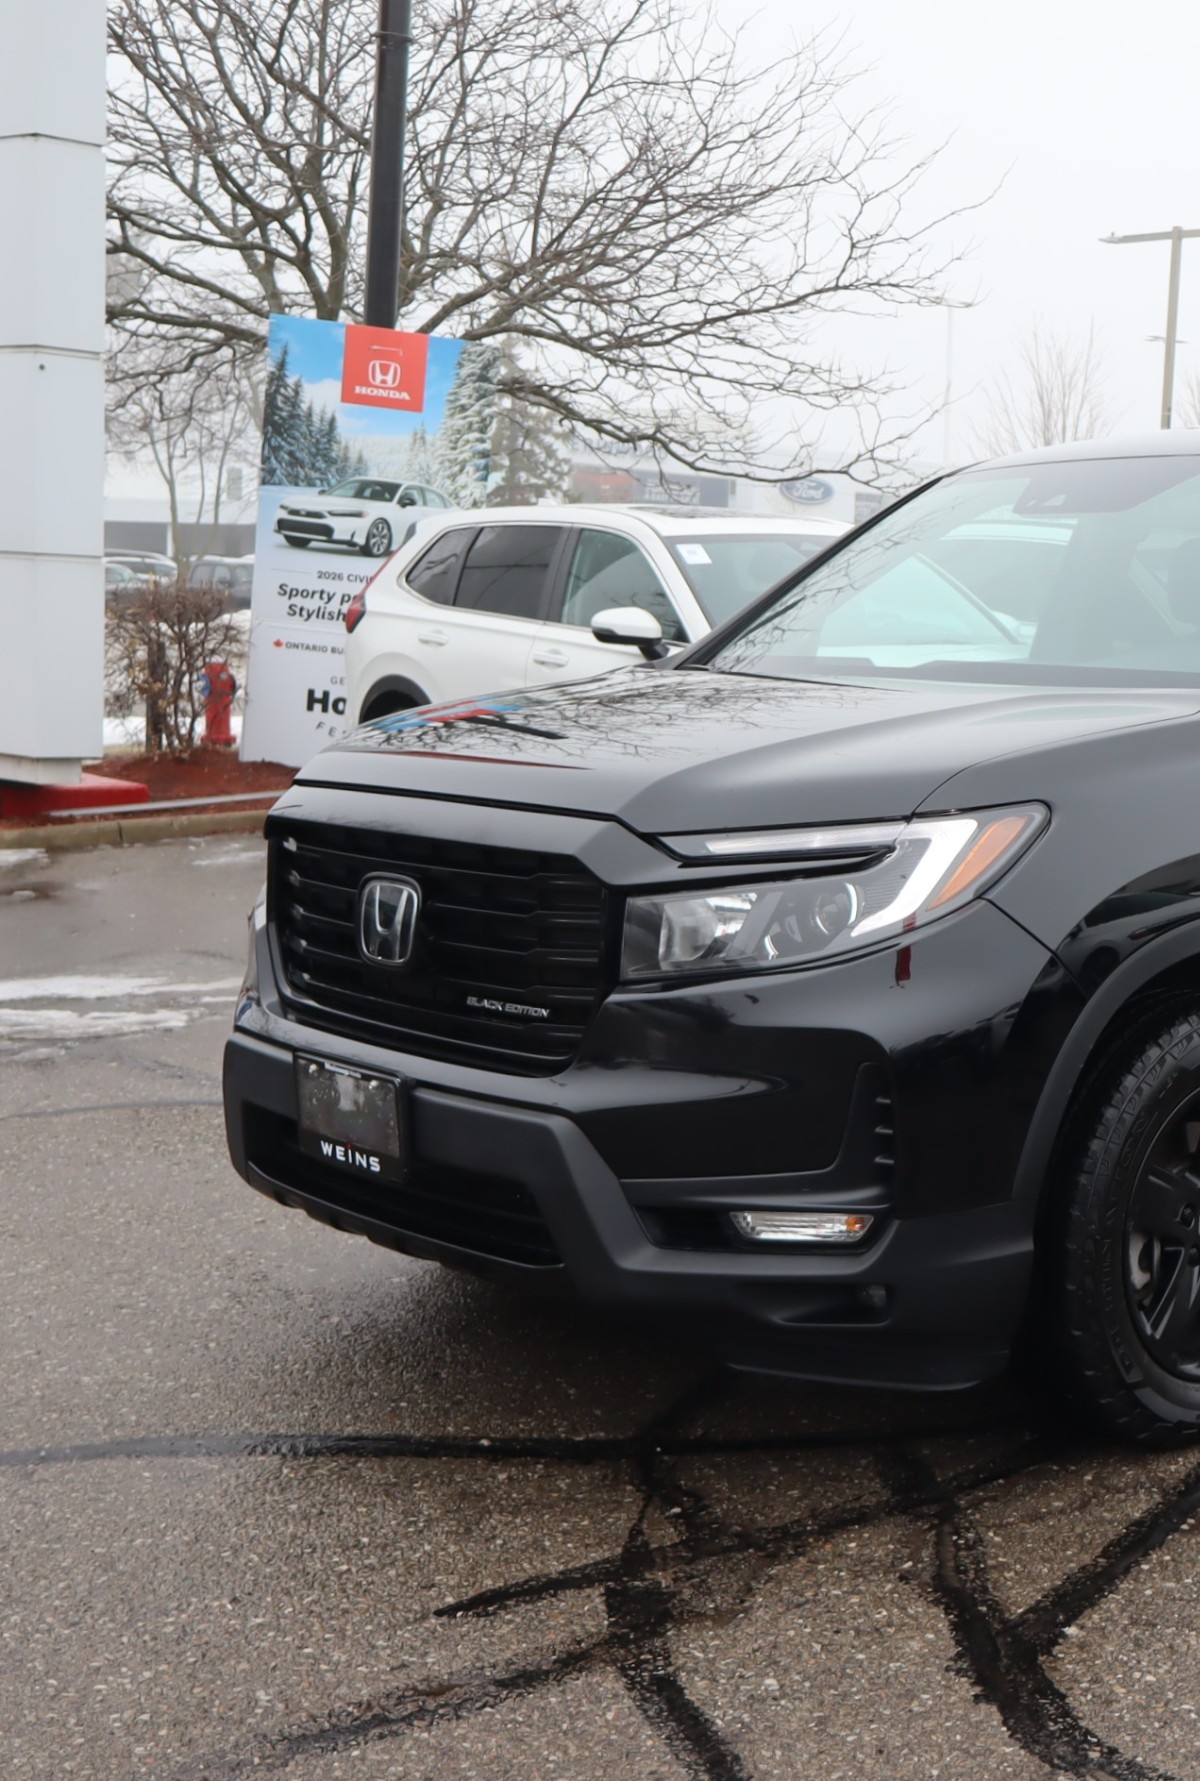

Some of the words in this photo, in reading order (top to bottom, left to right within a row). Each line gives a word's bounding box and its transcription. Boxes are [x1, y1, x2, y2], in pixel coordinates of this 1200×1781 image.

[354, 385, 411, 401] HONDA
[791, 479, 824, 499] Ford
[317, 570, 344, 581] 2026
[277, 583, 336, 604] Sporty
[287, 603, 347, 622] Stylish
[285, 641, 328, 653] ONTARIO
[466, 996, 502, 1011] BLACK
[505, 1003, 550, 1018] EDITION
[320, 1140, 381, 1172] WEINS
